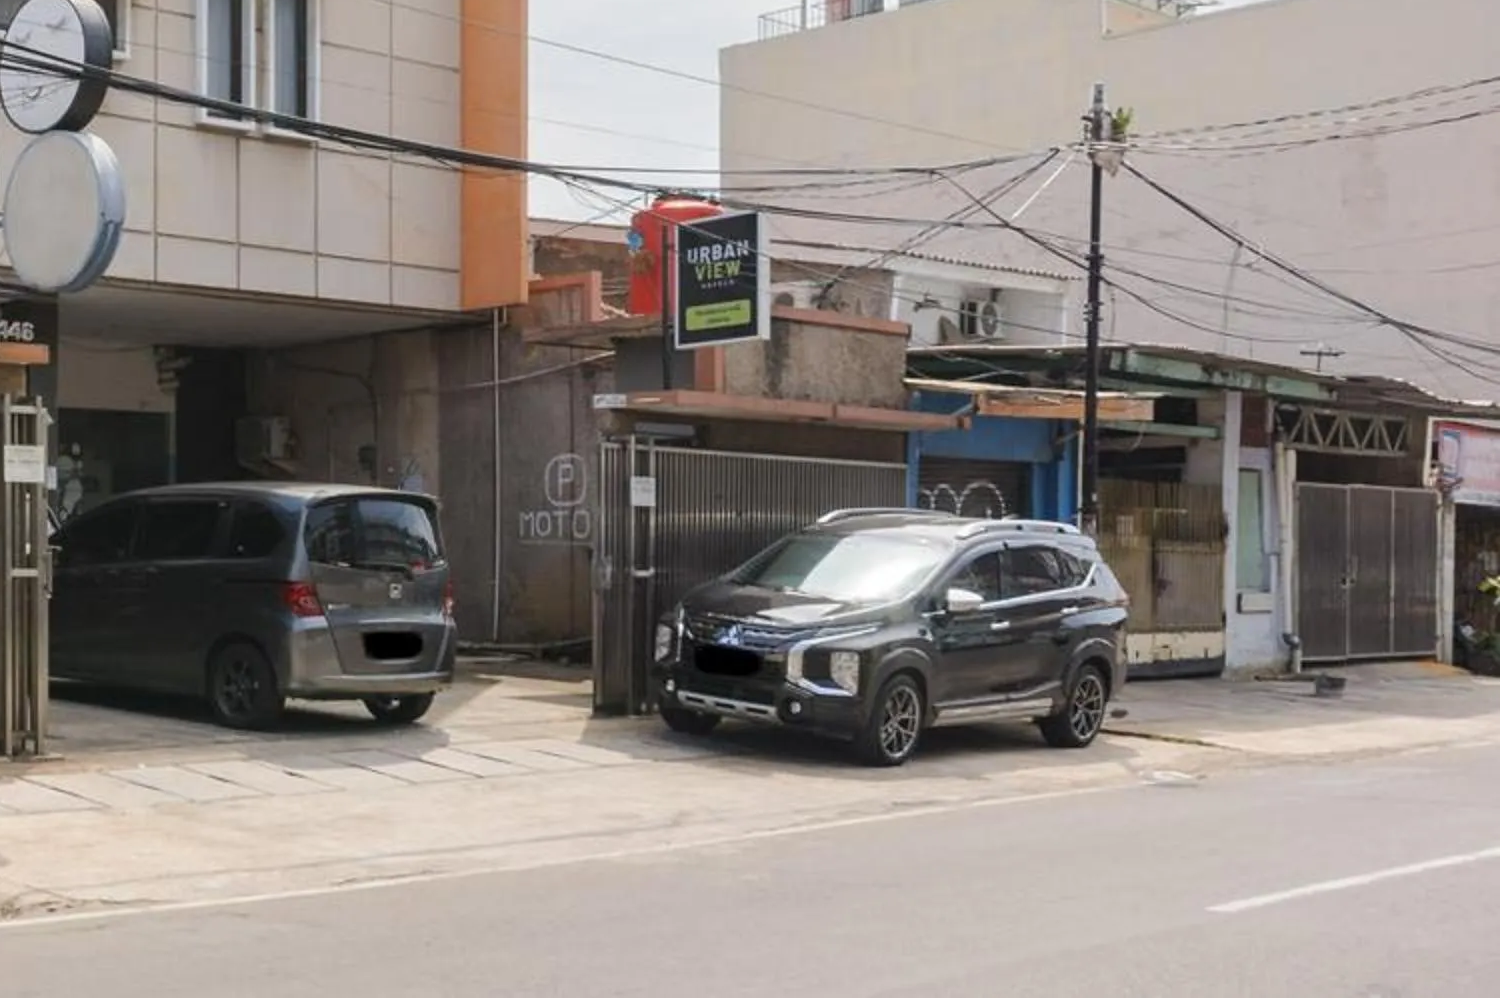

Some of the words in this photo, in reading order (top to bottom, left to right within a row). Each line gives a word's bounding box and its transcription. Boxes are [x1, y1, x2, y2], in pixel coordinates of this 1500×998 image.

[687, 239, 749, 263] URBAN
[695, 259, 741, 281] VIEW
[557, 463, 574, 498] P
[519, 510, 591, 539] MOTO
